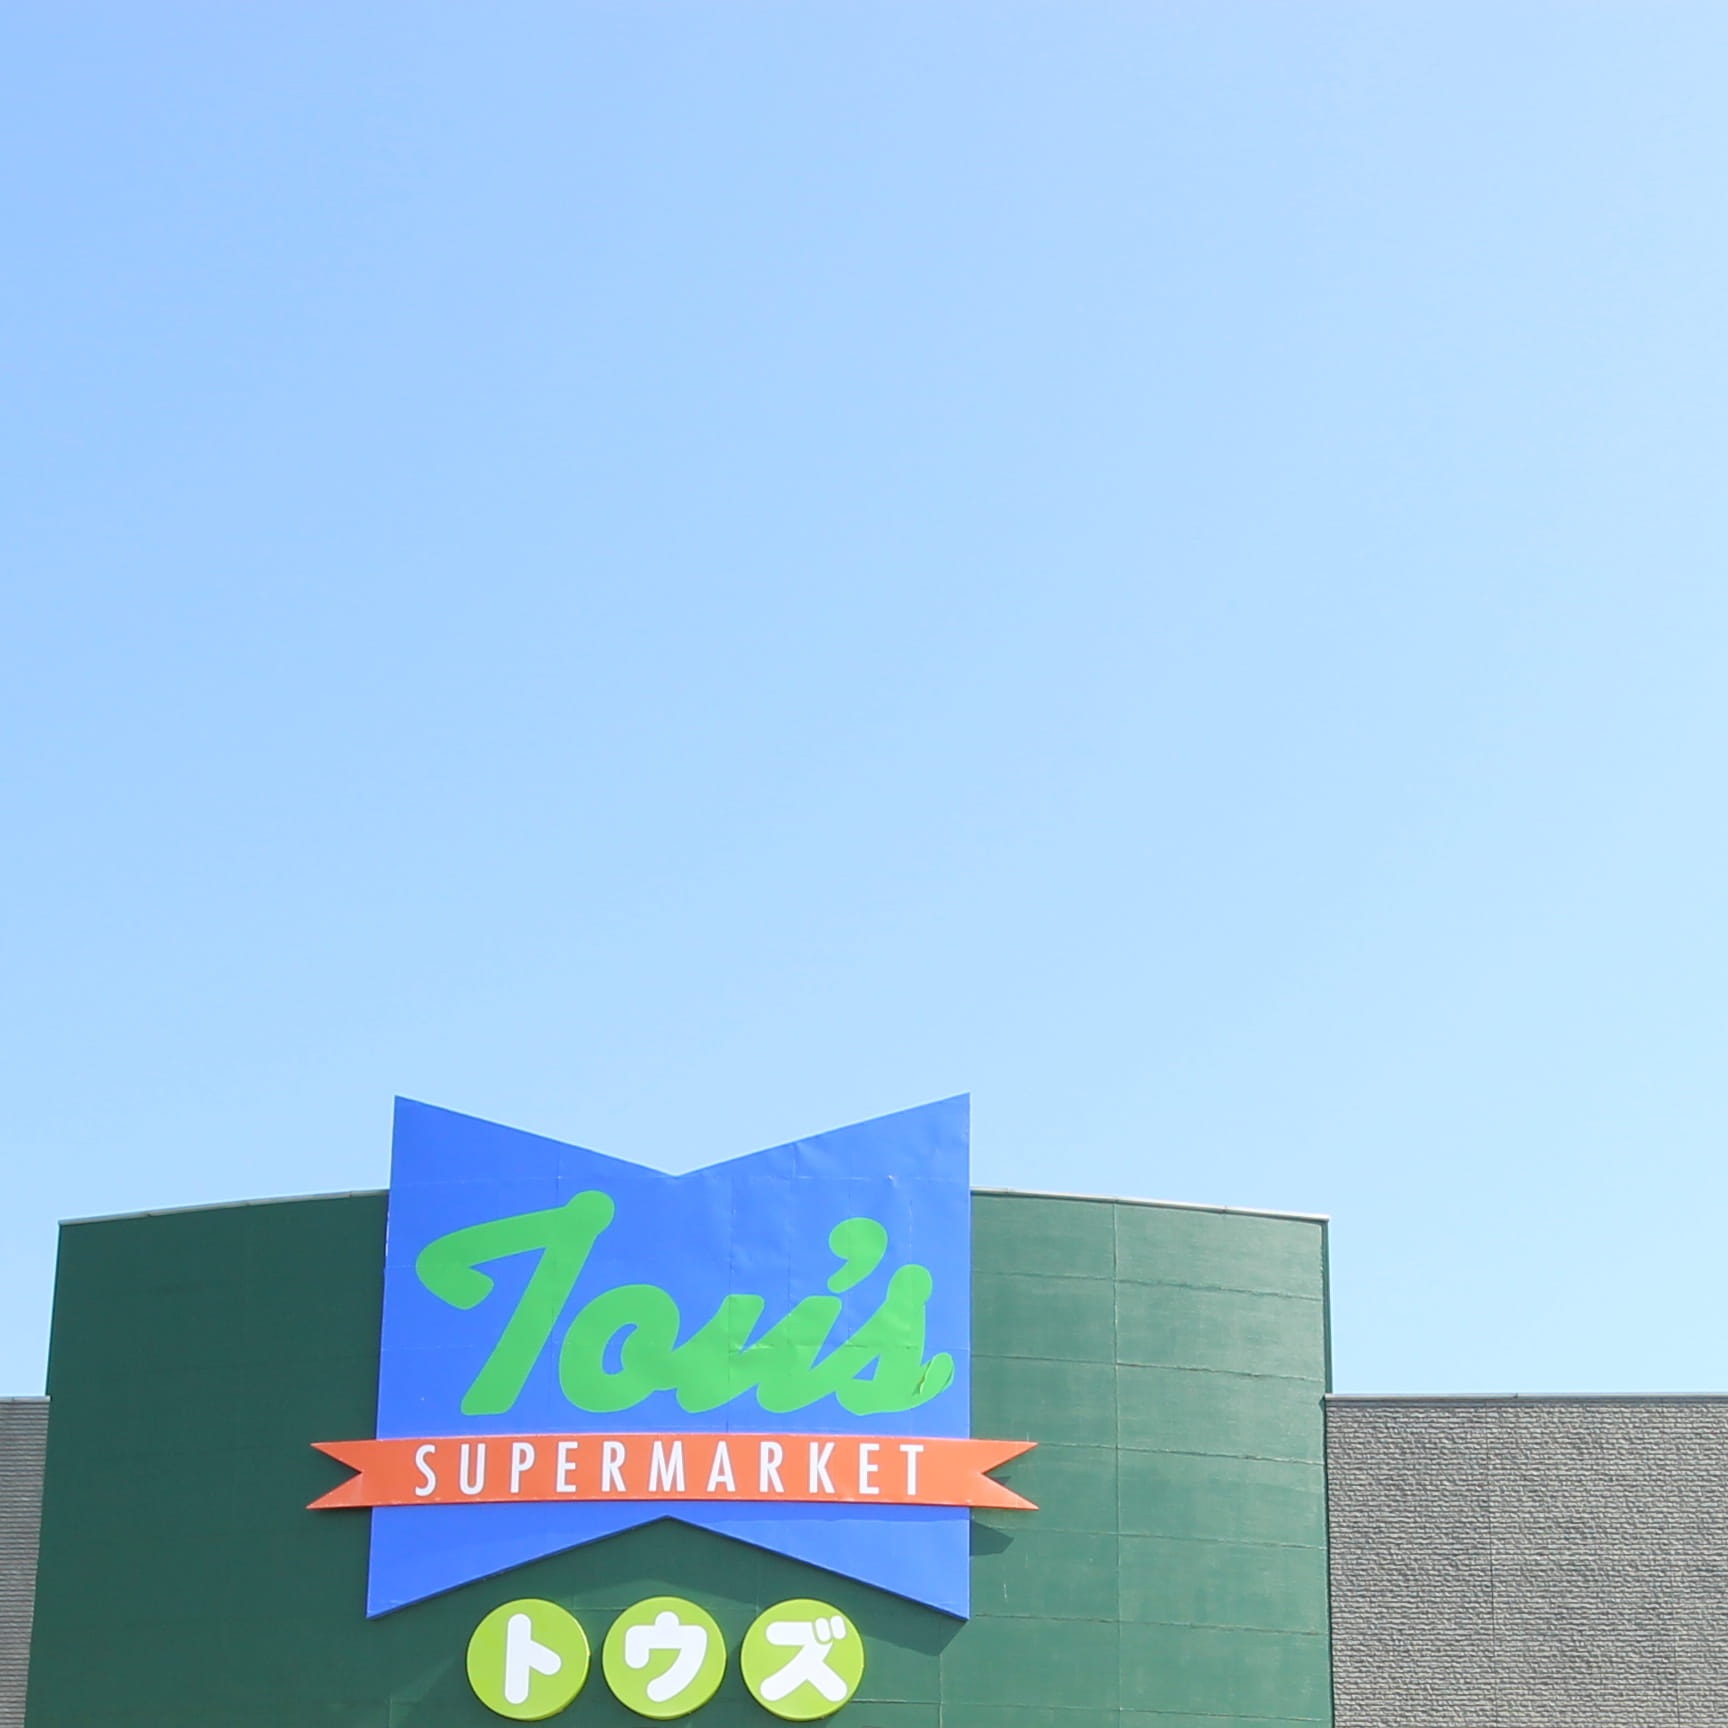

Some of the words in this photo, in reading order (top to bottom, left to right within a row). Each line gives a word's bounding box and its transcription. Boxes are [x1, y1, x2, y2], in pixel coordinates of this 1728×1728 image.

[415, 1190, 954, 1416] Tou's
[415, 1441, 924, 1497] SUPERMARKET
[504, 1611, 848, 1705] トウズ
